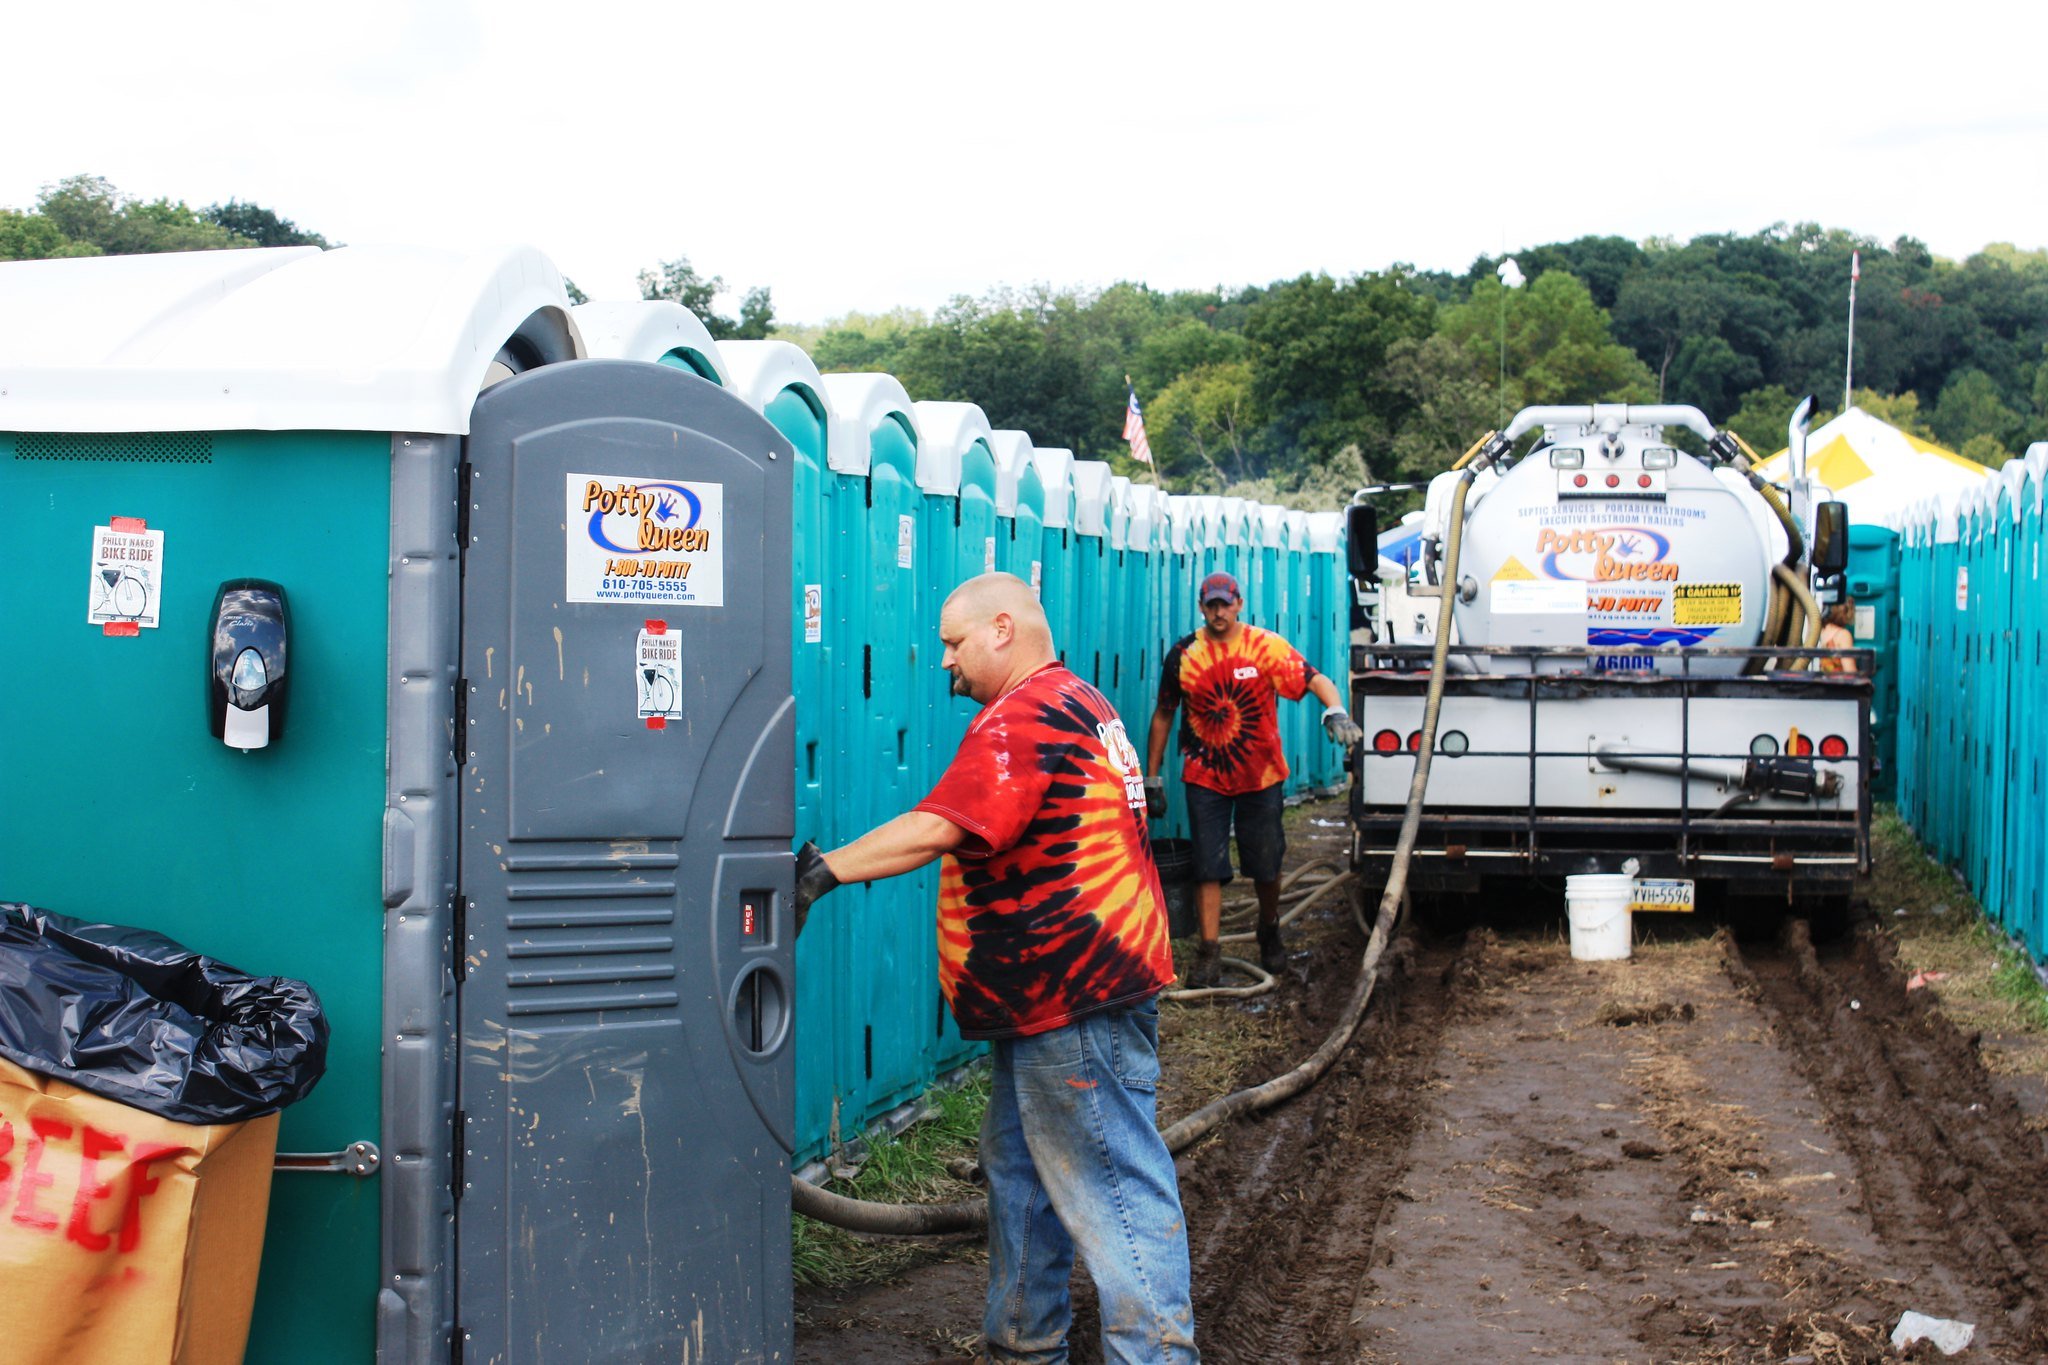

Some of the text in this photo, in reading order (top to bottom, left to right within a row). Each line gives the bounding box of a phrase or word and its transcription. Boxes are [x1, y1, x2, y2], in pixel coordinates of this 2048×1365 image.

[583, 480, 655, 519] Potty
[1518, 504, 1706, 519] SEPTIC SERVICES PORTABLE RESTROOMS
[1539, 514, 1684, 527] EXECUTIVE RESTROOM TRAILERS
[637, 518, 709, 551] Queen
[102, 537, 154, 548] PHILLY NAKED
[1536, 528, 1615, 556] Potty
[102, 547, 154, 561] BIKE RIDE
[604, 558, 691, 579] 1-800-TO POTTY
[1594, 556, 1679, 581] Queen
[602, 579, 687, 592] 610-705-5555
[1686, 588, 1729, 597] CAUTION
[596, 590, 696, 601] www.pottyqueen.com
[1616, 597, 1663, 613] POTTY
[641, 639, 677, 648] PHILLY NAKED
[642, 648, 677, 661] BIKE RIDE
